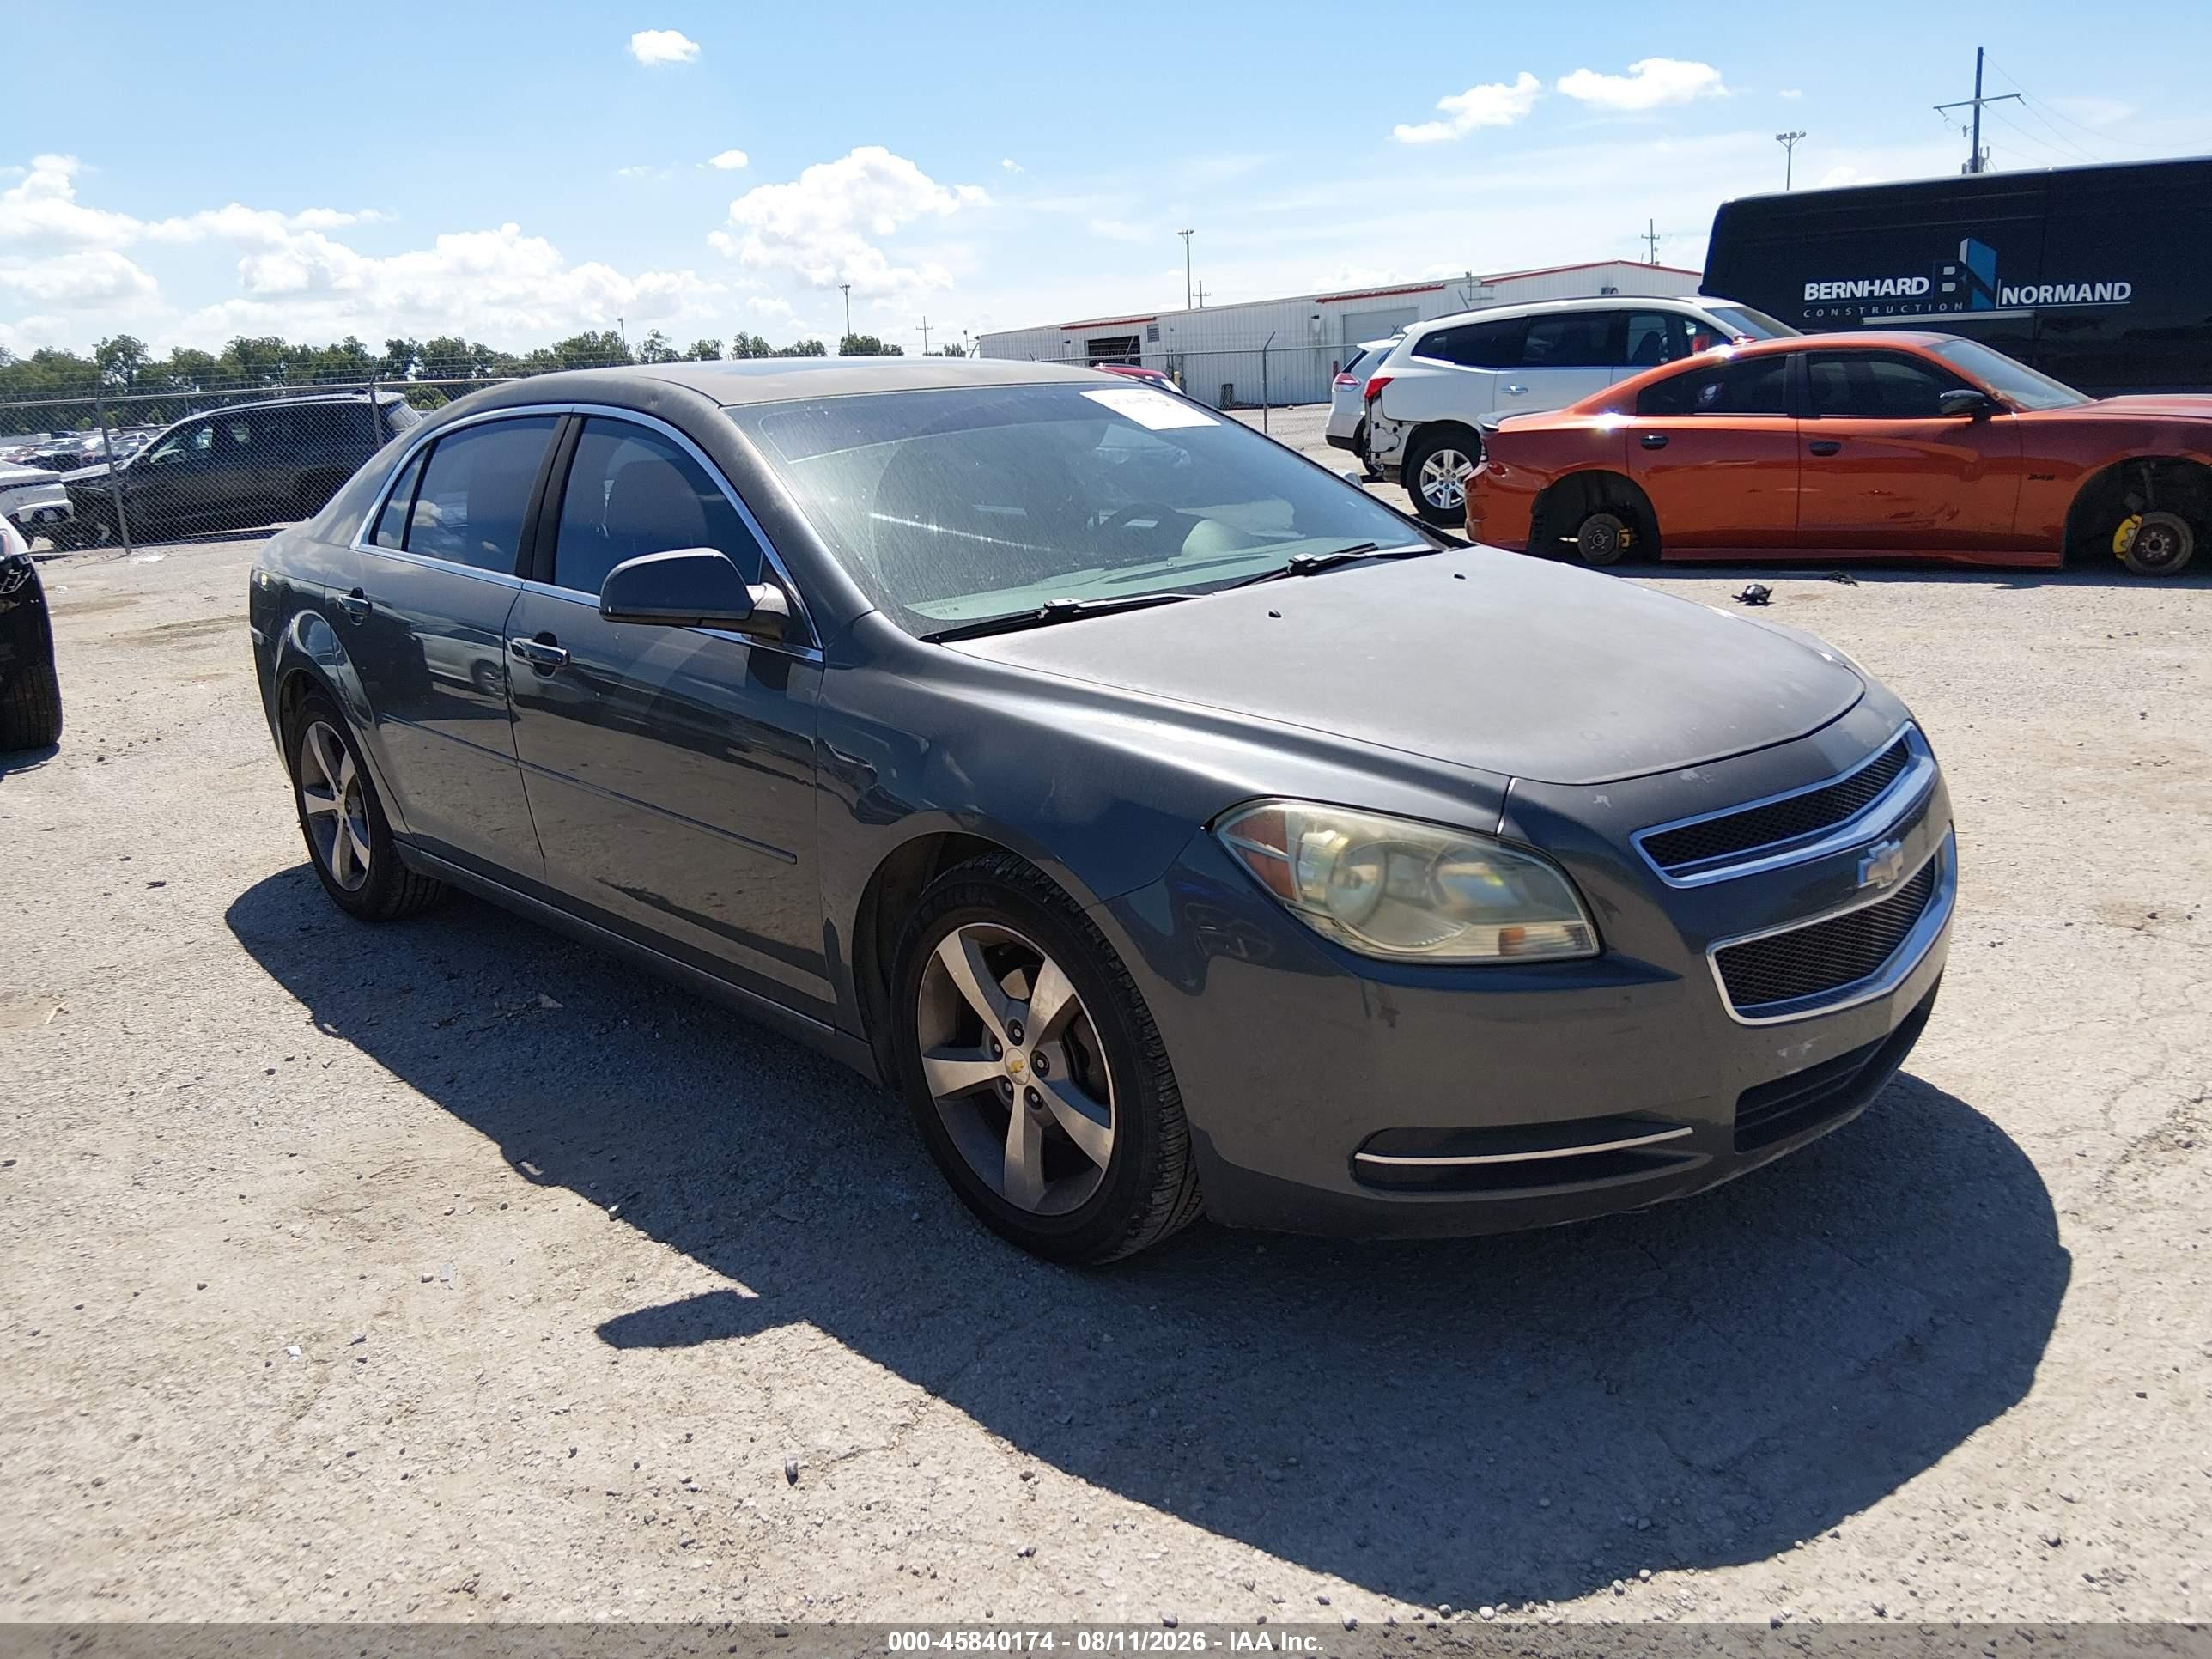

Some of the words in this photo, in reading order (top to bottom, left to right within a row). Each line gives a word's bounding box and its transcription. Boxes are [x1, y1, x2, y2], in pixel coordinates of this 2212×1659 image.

[1804, 276, 1930, 301] BERNHARD
[2001, 282, 2132, 305] NORMAND
[1803, 301, 1964, 318] CONSTRUCTION
